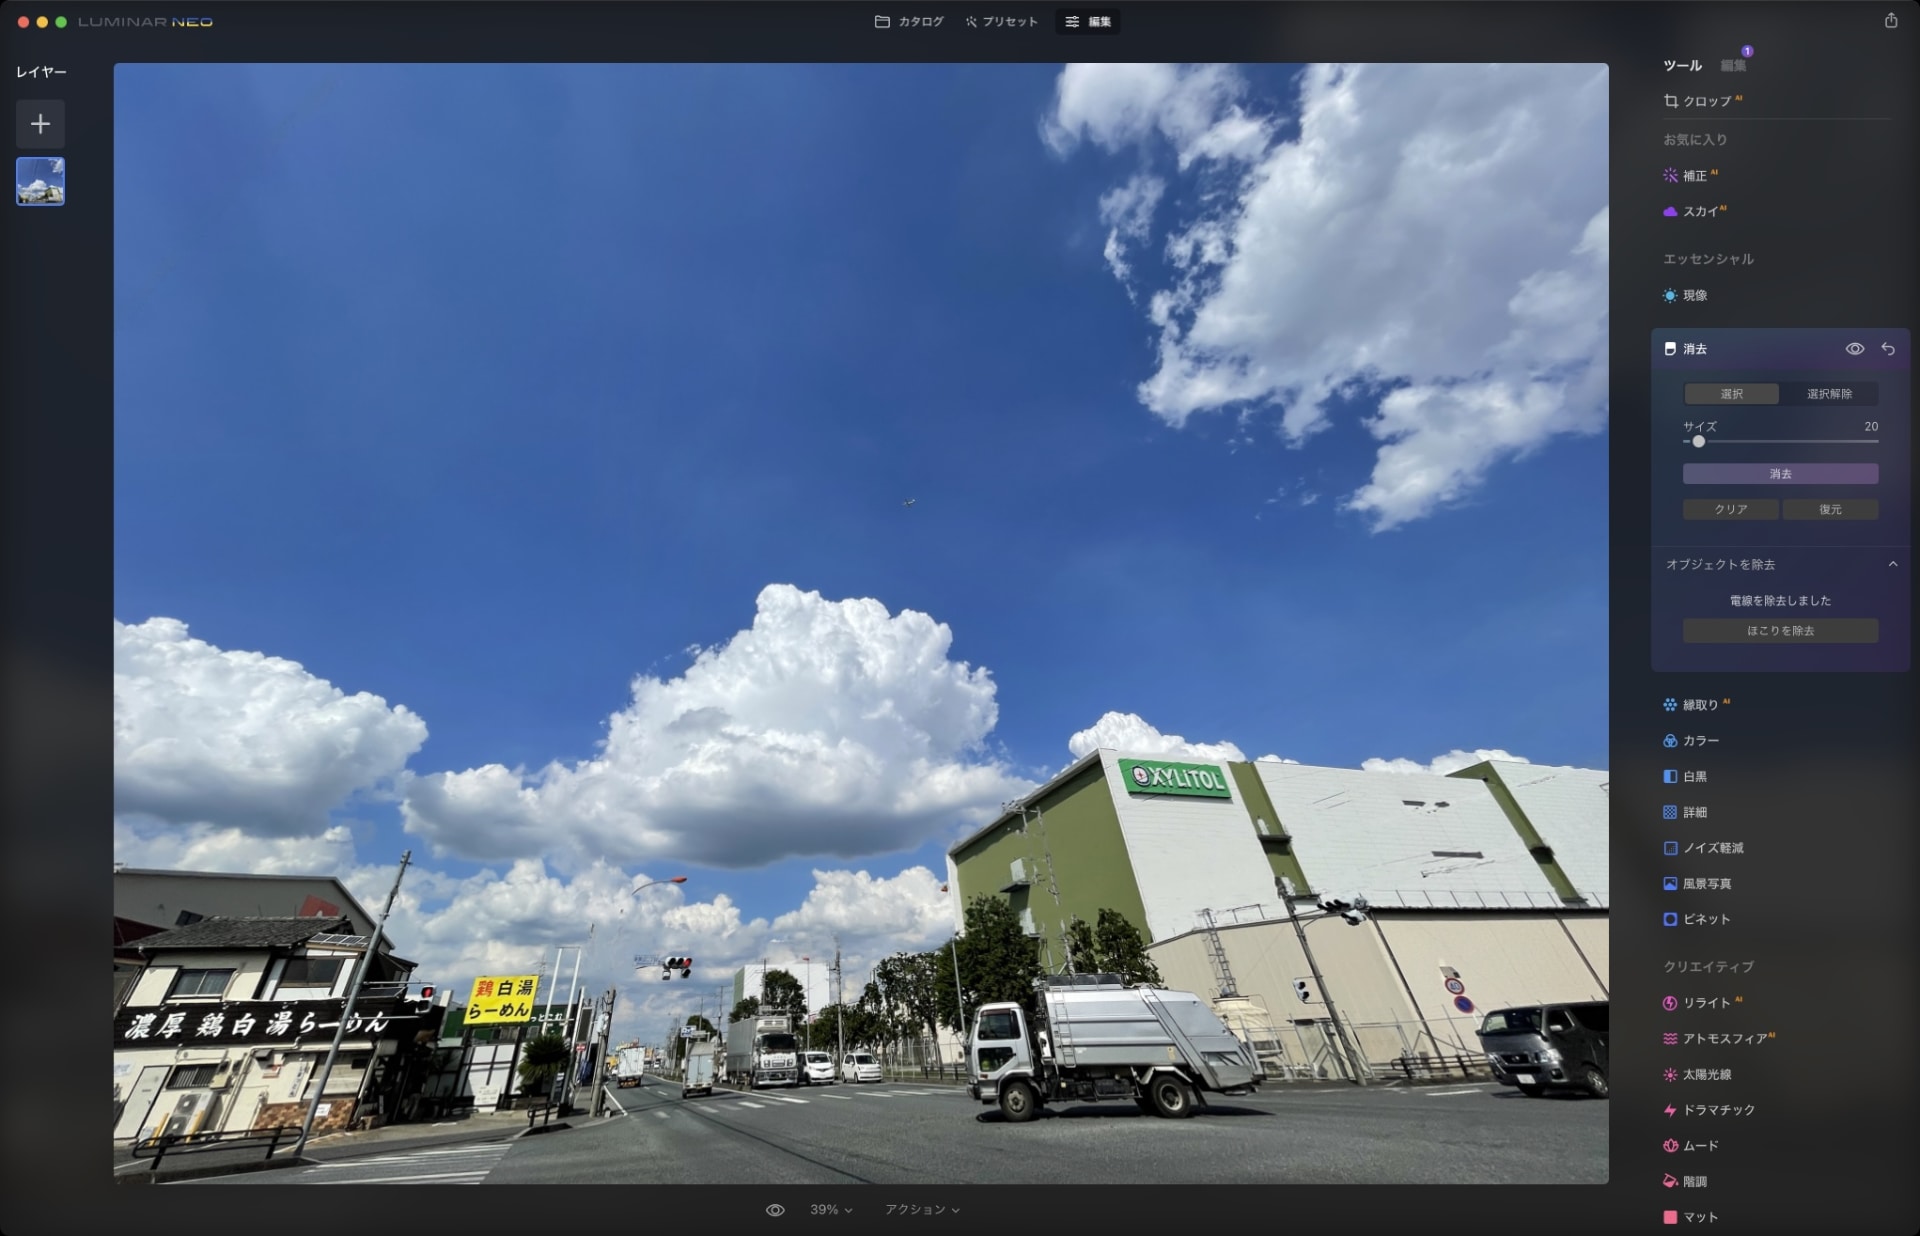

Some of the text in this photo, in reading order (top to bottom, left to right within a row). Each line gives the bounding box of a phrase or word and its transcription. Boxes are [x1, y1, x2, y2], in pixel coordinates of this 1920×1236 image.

[79, 18, 213, 27] LUMINAR NEO
[900, 16, 944, 27] カタログ
[984, 16, 1037, 27] プリセット
[1089, 16, 1111, 27] 編集
[1664, 60, 1702, 71] ツール
[1720, 59, 1747, 72] 編集
[18, 66, 66, 78] レイヤー
[1685, 96, 1731, 107] クロップ
[1664, 133, 1726, 146] お気に入り
[1684, 170, 1707, 182] 補正
[1684, 206, 1718, 217] スカイ
[1664, 254, 1754, 265] エッセンシャル
[1683, 289, 1707, 301] 現像
[1684, 343, 1707, 355] 消去
[1721, 389, 1743, 399] 選択
[1808, 389, 1852, 399] 選択解除
[1684, 421, 1717, 432] サイズ
[1865, 422, 1878, 431] 20
[1770, 468, 1792, 479] 消去
[1716, 504, 1747, 514] クリア
[1820, 504, 1841, 515] 復元
[1667, 558, 1775, 570] オブジェクトを除去
[1731, 595, 1831, 607] 電線を除去しました
[1748, 626, 1814, 636] ほこりを除去
[1684, 699, 1717, 711] 縁取り
[1684, 735, 1719, 746] カラー
[1685, 771, 1707, 782] 白黒
[1684, 807, 1707, 818] 詳細
[1685, 842, 1744, 854] ノイズ軽減
[1683, 878, 1732, 890] 風景写真
[1685, 914, 1730, 925] ビネット
[1665, 960, 1754, 973] クリエイティブ
[475, 979, 533, 998] 鶏白湯
[1686, 998, 1730, 1008] リライト
[468, 1002, 530, 1020] らーめん
[1684, 1033, 1767, 1044] アトモスフィア
[1684, 1069, 1732, 1080] 太陽光線
[1686, 1105, 1754, 1116] ドラマチック
[1684, 1140, 1718, 1151] ムード
[1684, 1176, 1707, 1187] 階調
[811, 1204, 838, 1214] 39%
[886, 1204, 945, 1215] アクション
[1684, 1212, 1717, 1223] マット
